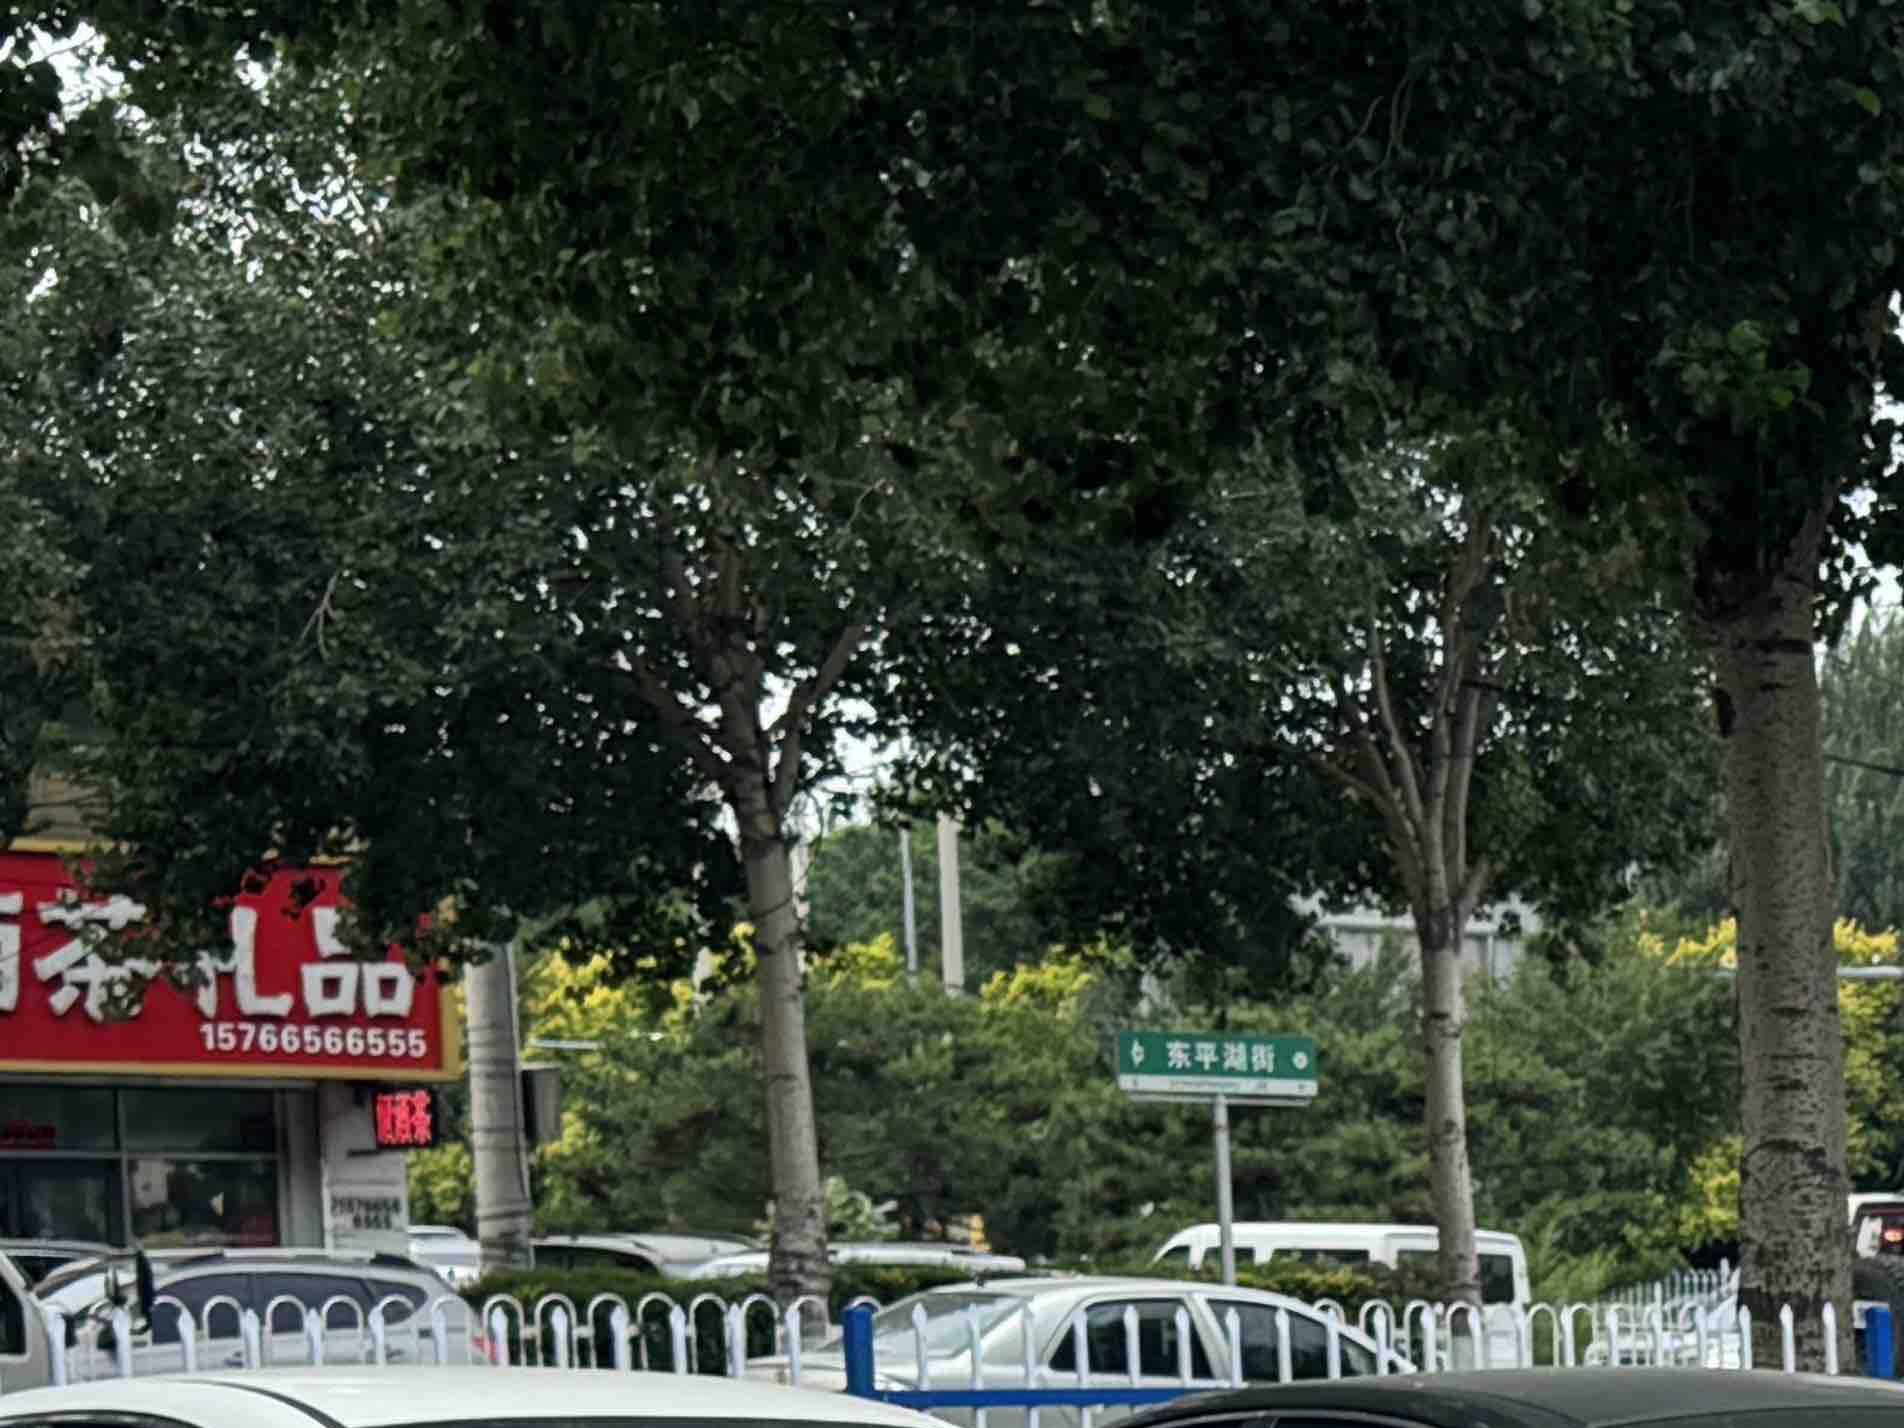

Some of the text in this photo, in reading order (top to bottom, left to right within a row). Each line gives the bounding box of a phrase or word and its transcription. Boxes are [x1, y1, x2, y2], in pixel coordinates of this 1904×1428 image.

[0, 888, 418, 1020] 茶礼品
[201, 1023, 427, 1057] 15766566555
[1166, 1040, 1275, 1073] 东平湖街
